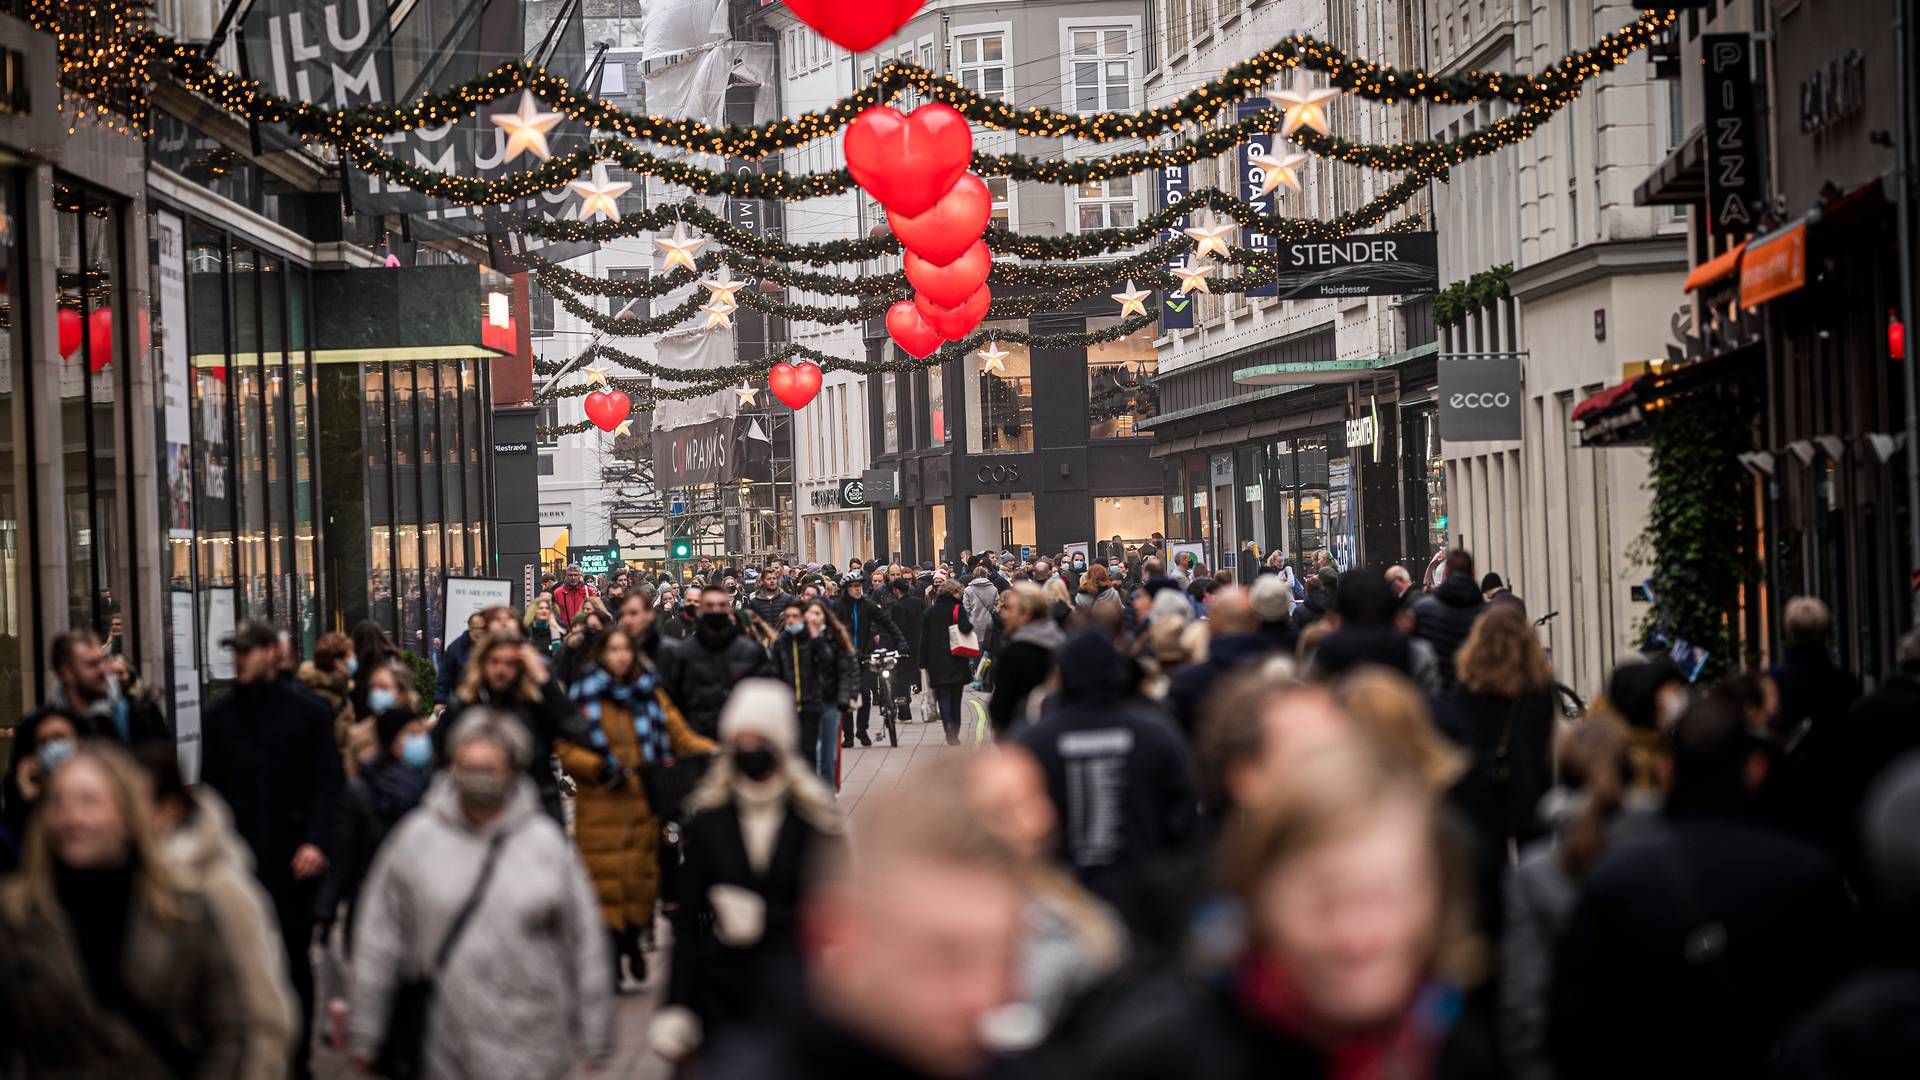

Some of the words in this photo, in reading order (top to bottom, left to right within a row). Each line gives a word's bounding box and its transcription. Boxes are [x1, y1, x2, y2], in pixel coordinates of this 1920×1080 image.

[1713, 42, 1751, 225] PIZZA
[1291, 240, 1399, 266] STENDER
[1320, 285, 1370, 295] Hairdresser
[1449, 392, 1510, 409] ecco
[977, 464, 1020, 483] COS
[866, 480, 892, 491] COS
